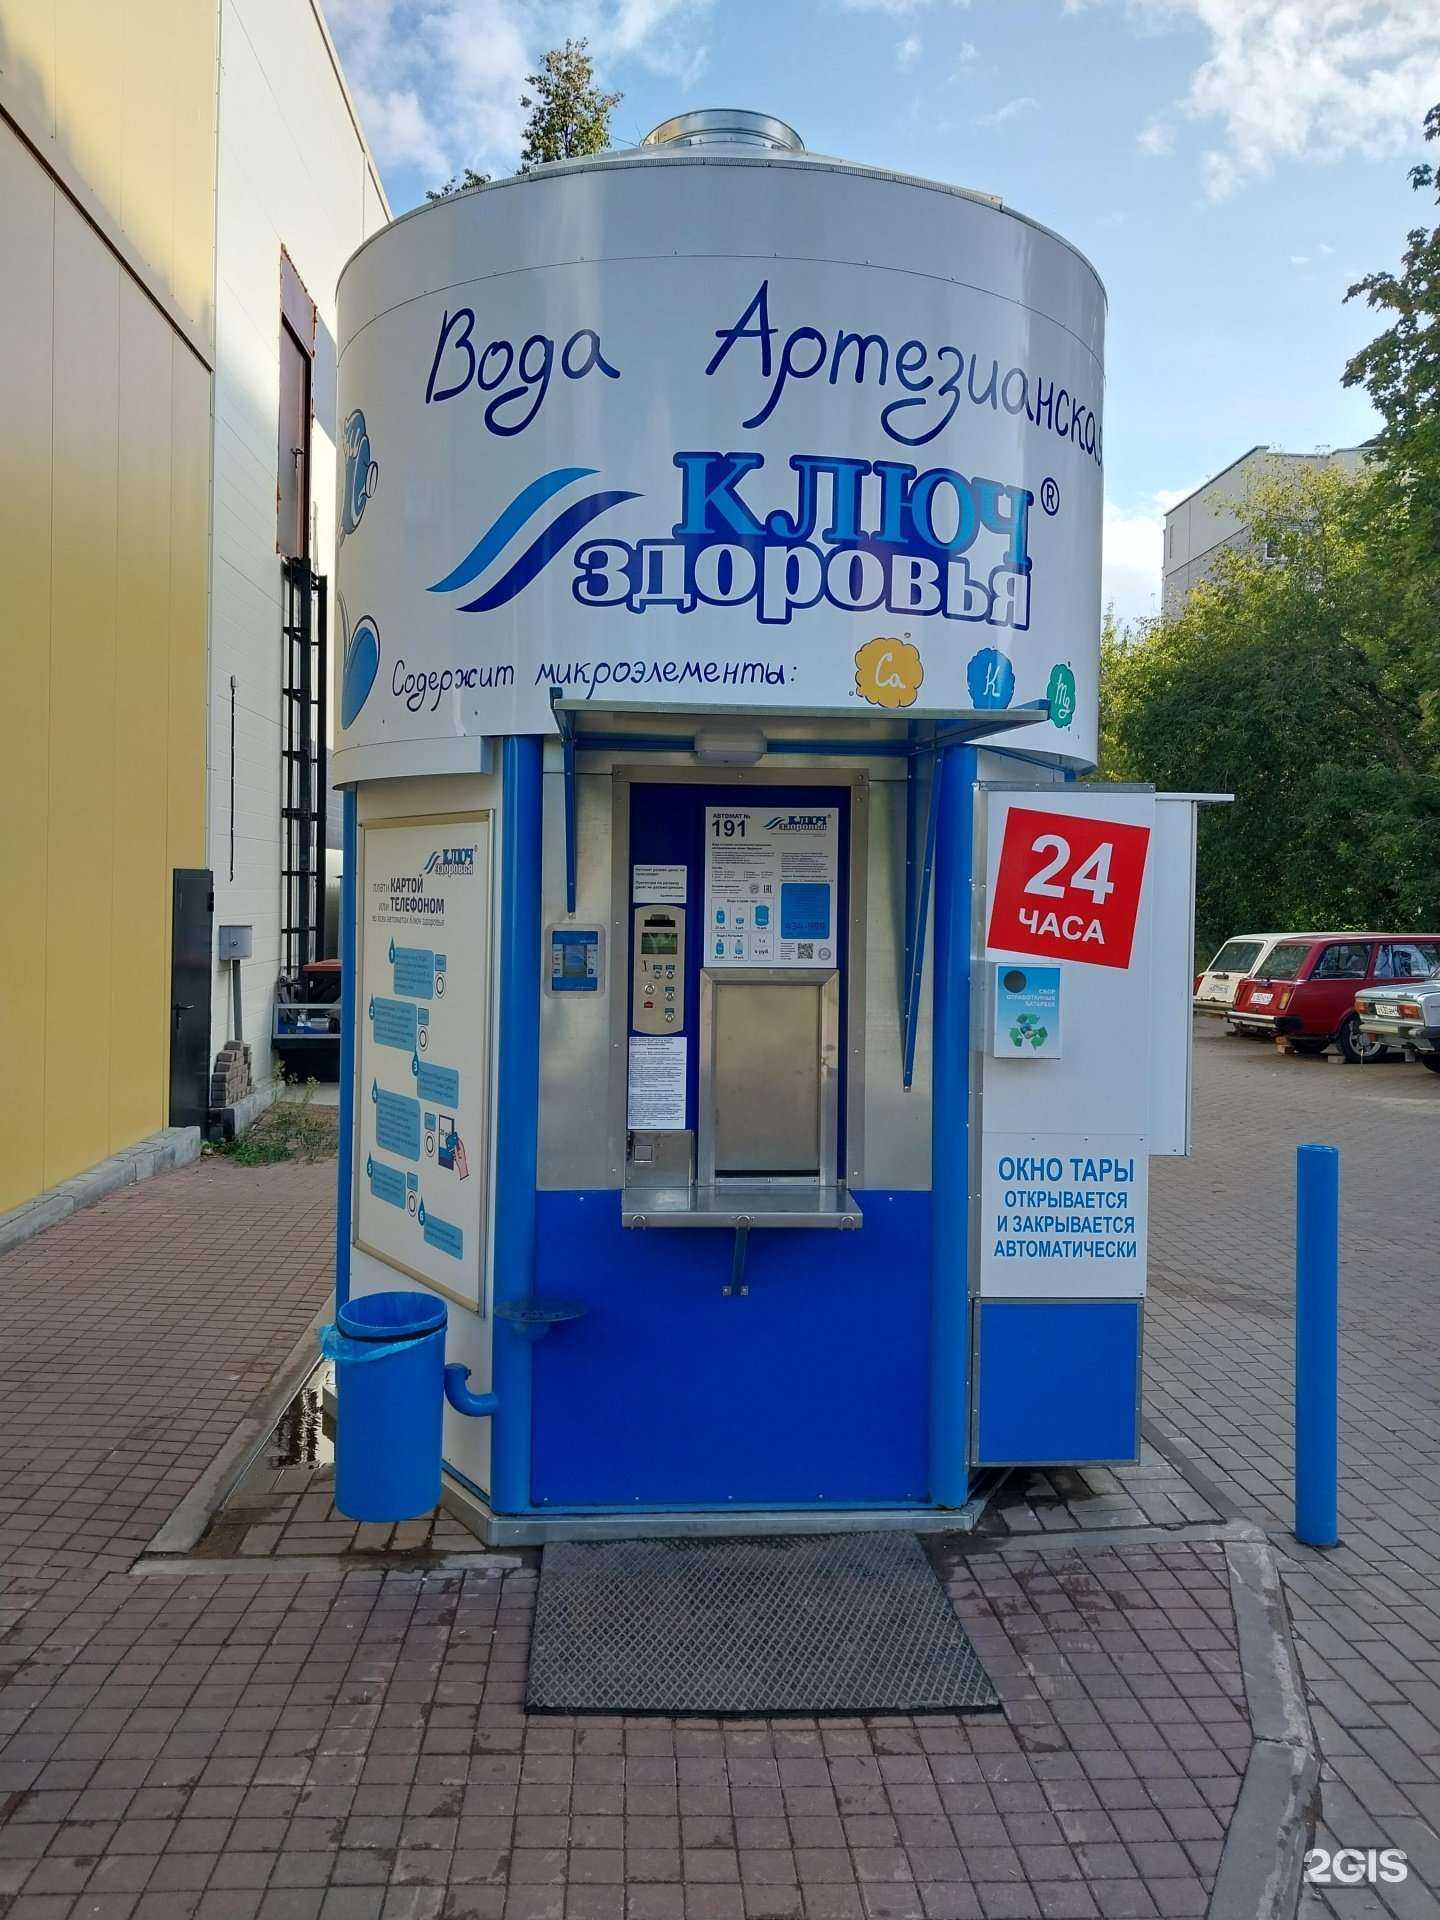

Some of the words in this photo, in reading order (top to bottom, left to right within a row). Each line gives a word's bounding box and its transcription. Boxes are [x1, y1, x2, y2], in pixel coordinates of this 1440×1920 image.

[425, 308, 621, 437] Вода
[673, 451, 1034, 571] КЛЮЧ
[572, 538, 1031, 631] здоровья
[391, 659, 515, 713] Содержит
[534, 661, 798, 700] микроэлементы:
[711, 819, 746, 838] 191
[442, 848, 474, 865] КЛЮЧ
[1023, 834, 1115, 905] 24
[390, 874, 424, 893] КАРТОЙ
[390, 897, 445, 914] ТЕЛЕФОНОМ
[1018, 907, 1105, 945] ЧАСА
[998, 1156, 1063, 1181] ОКНО
[1069, 1158, 1134, 1182] ТАРЫ
[1004, 1190, 1128, 1209] ОТКРЫВАЕТСЯ
[997, 1215, 1008, 1233] И
[1012, 1215, 1135, 1234] ЗАКРЫВАЕТСЯ
[993, 1239, 1137, 1258] АВТОМАТИЧЕСКИ
